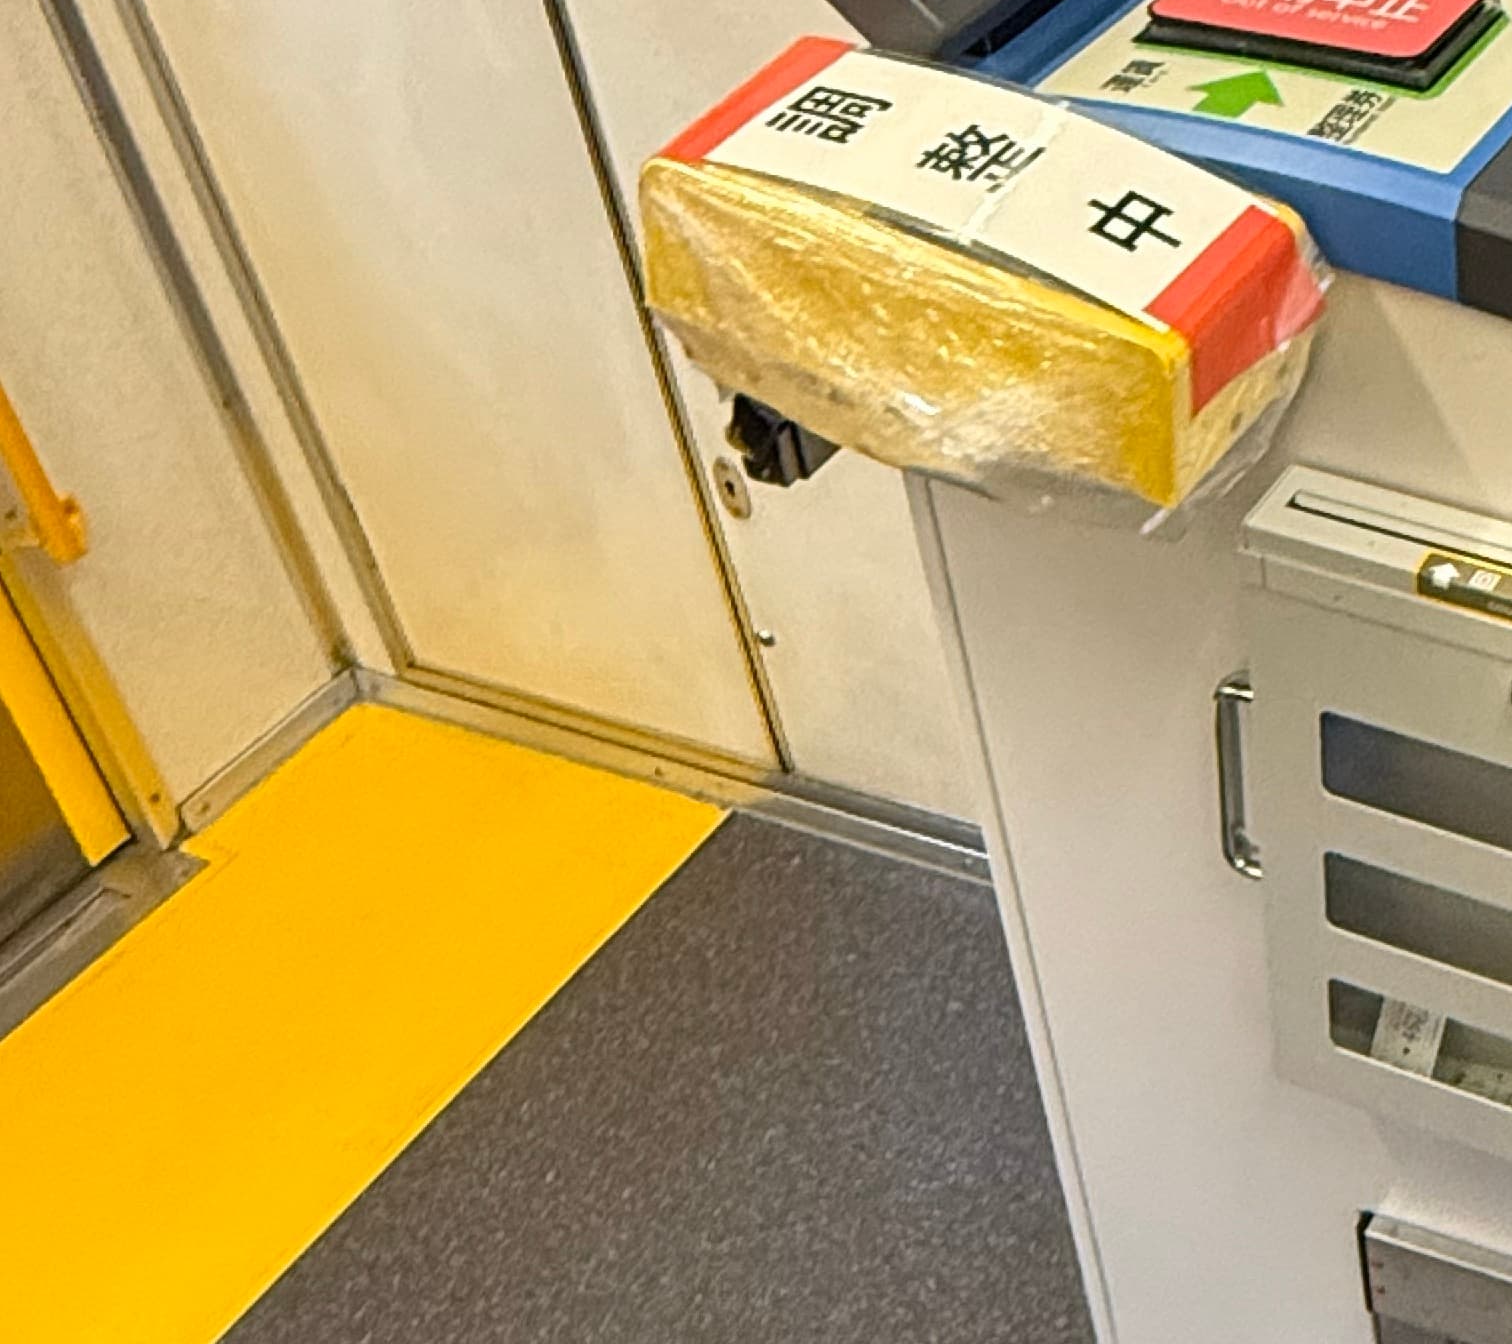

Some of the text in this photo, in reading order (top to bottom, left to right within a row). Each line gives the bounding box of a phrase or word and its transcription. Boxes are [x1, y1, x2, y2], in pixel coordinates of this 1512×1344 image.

[1272, 1, 1304, 15] of
[766, 85, 1186, 254] 調整中
